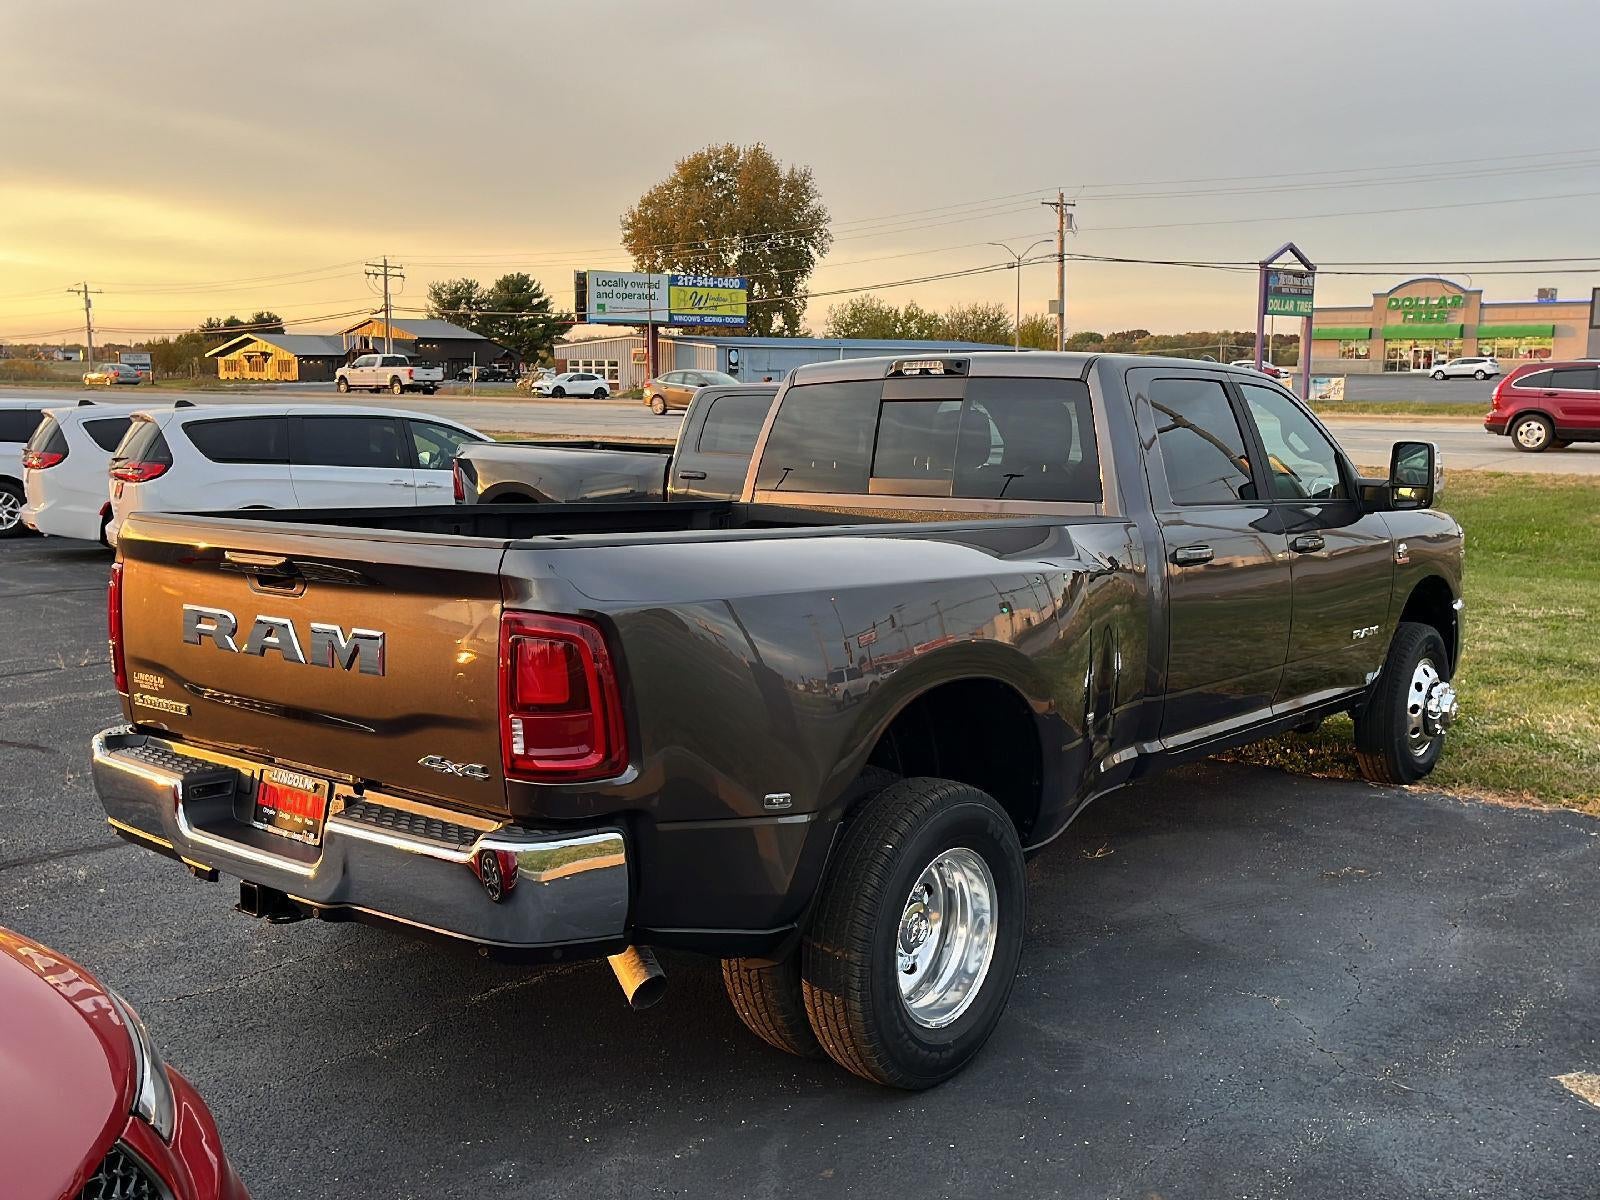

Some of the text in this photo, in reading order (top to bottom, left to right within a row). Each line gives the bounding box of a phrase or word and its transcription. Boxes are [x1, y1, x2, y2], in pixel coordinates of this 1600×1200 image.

[596, 277, 660, 290] Locally owned
[677, 276, 740, 288] 217-544-0400
[596, 290, 659, 301] and operated.
[1387, 294, 1464, 311] DOLLAR
[1268, 299, 1313, 313] DOLLAR TREE
[673, 315, 701, 323] WINDOWS
[183, 603, 386, 677] RAM
[133, 671, 164, 685] LINCOLN
[271, 769, 315, 792] LINCOLN
